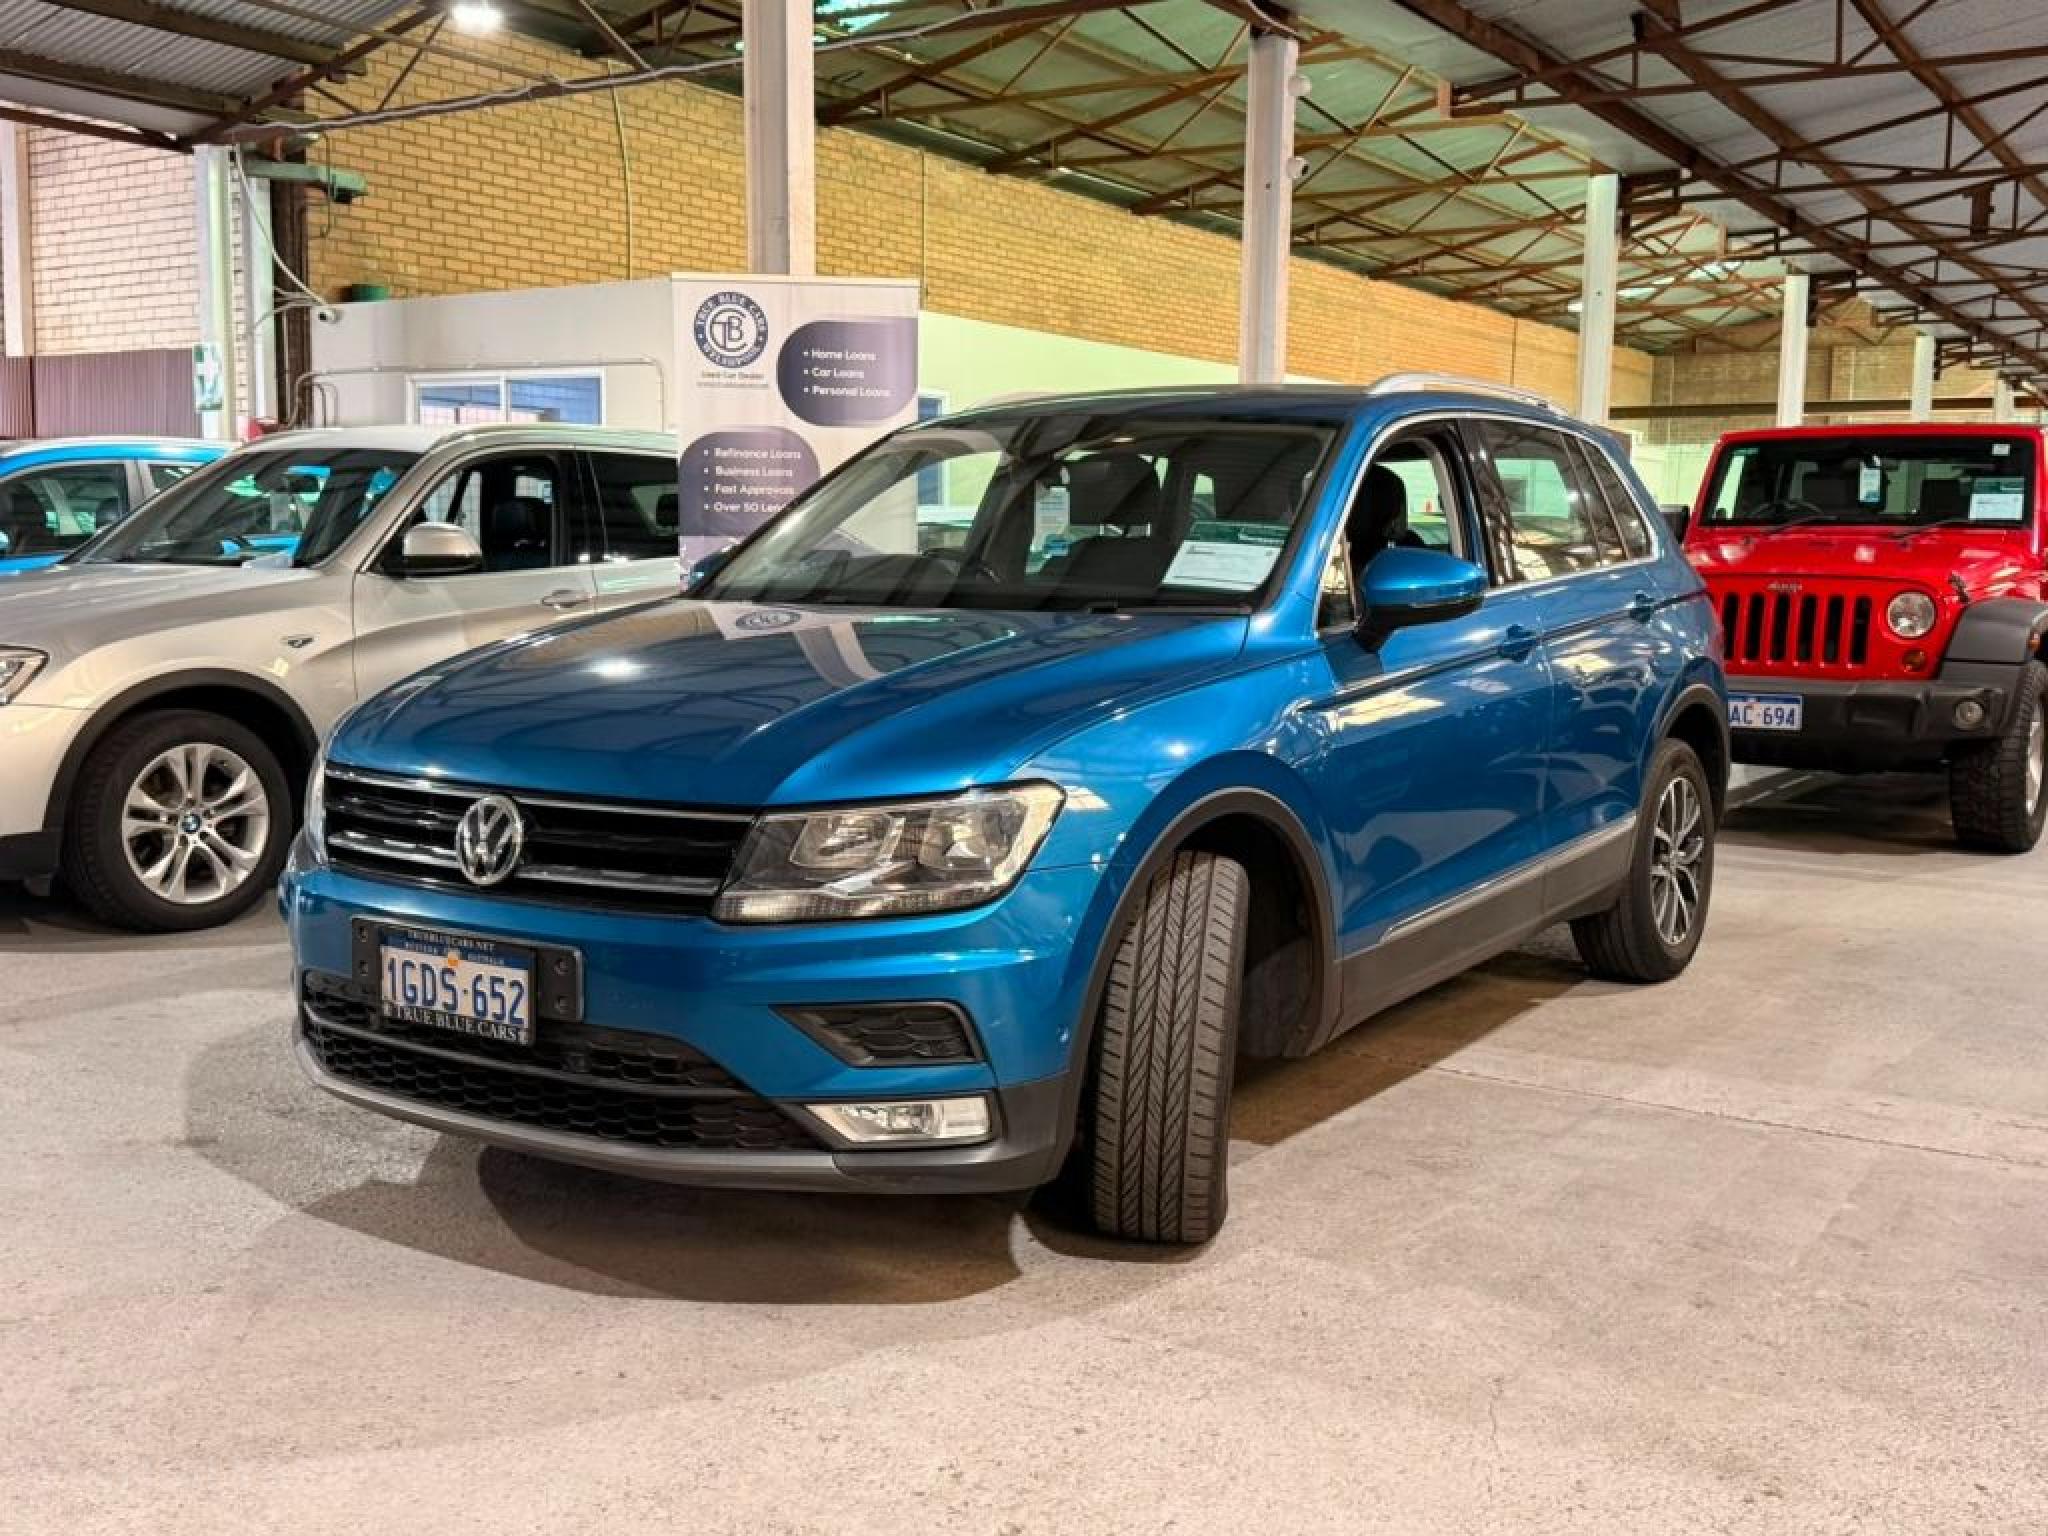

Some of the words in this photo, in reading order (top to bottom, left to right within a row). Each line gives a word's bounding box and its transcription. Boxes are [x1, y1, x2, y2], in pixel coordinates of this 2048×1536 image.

[811, 349, 843, 360] Home
[845, 350, 877, 361] Loans
[811, 367, 832, 377] Car
[834, 368, 865, 378] Loans
[811, 385, 857, 397] Personal
[859, 386, 892, 398] Loans
[714, 447, 768, 459] Refinance
[769, 448, 801, 460] Loans
[715, 465, 760, 477] Business
[761, 466, 793, 478] Loans
[715, 483, 737, 495] Fast
[713, 501, 741, 513] Over
